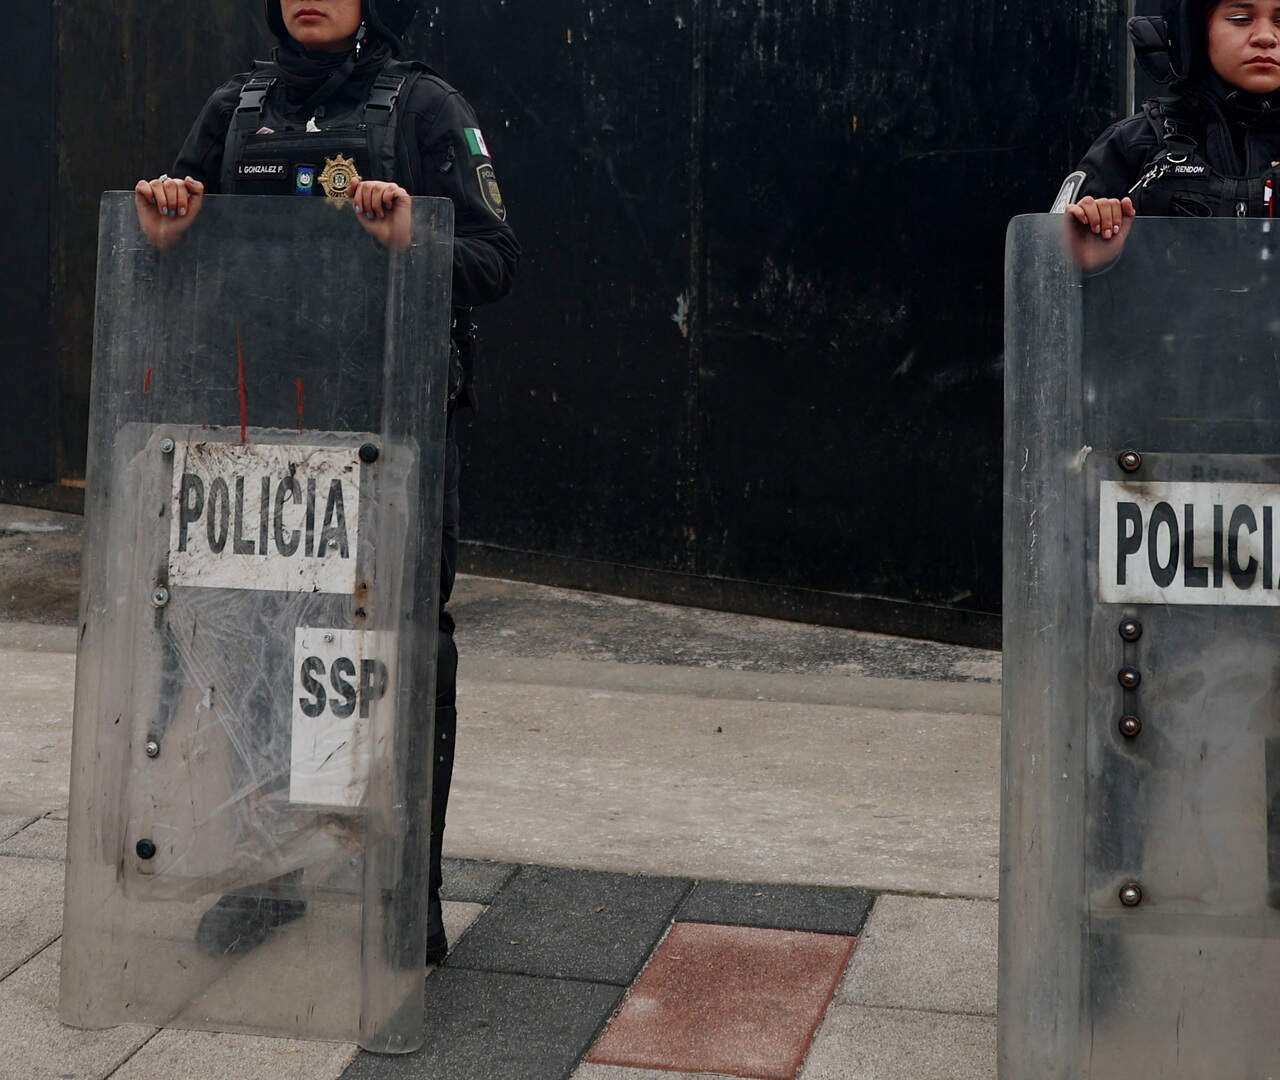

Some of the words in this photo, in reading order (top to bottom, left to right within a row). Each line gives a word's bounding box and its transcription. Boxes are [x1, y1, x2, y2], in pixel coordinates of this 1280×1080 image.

[244, 165, 277, 174] GONZALEZ
[1175, 165, 1204, 174] RENDON
[178, 472, 350, 560] POLICIA
[299, 656, 389, 719] SSP
